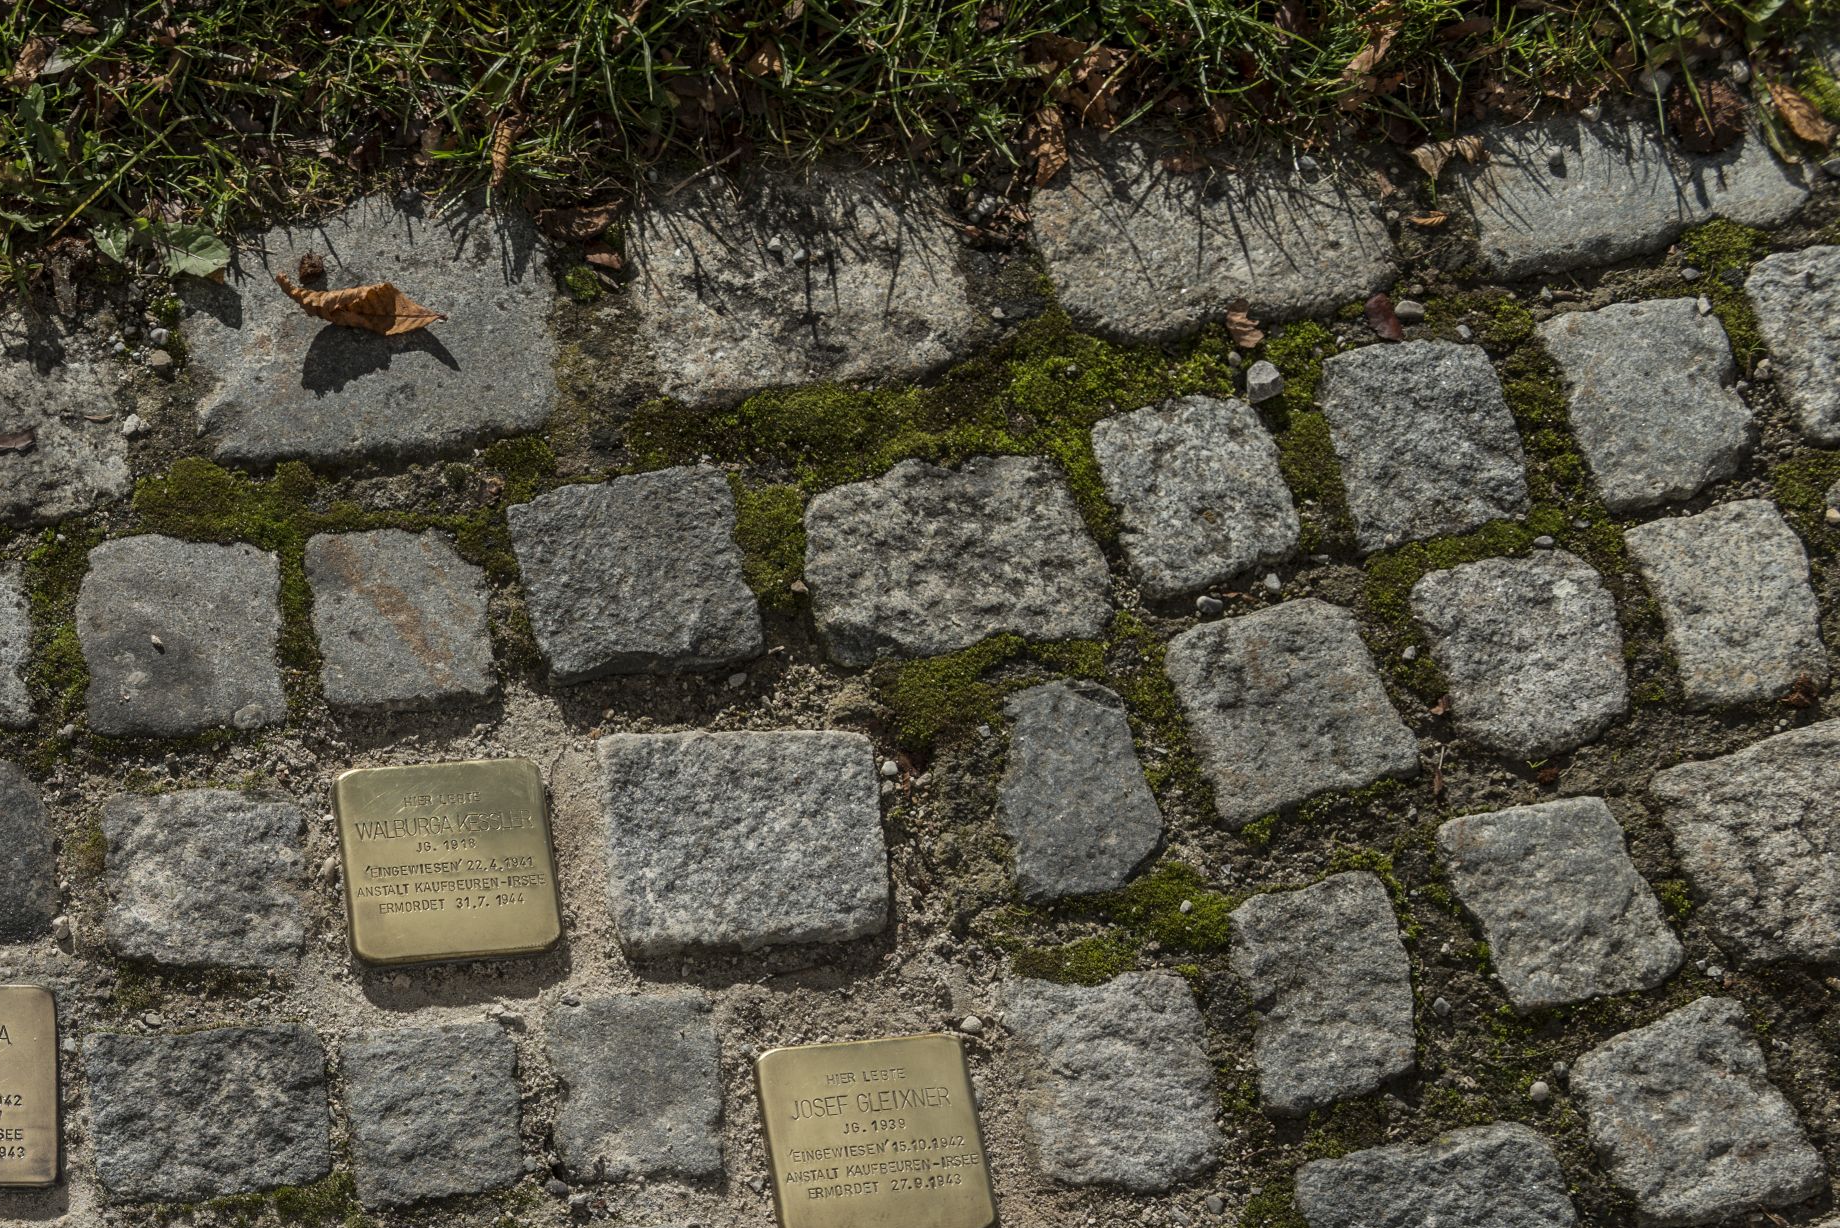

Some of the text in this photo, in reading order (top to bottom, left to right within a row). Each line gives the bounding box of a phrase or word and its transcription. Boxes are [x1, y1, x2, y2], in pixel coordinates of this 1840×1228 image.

[403, 792, 481, 807] HIER LEBTE
[355, 810, 535, 840] WALBURGA KESSLER
[416, 842, 437, 853] JG.
[357, 873, 546, 898] ANSTALT KAUFBEUREN-IRSEE
[379, 899, 445, 914] ERMORDET
[827, 1068, 906, 1085] HIER LEBTE
[791, 1087, 951, 1121] JOSEF GLEIXNER
[843, 1118, 906, 1135] JG. 1939
[786, 1154, 979, 1184] ANSTALT KAUFBEUREN-IRSEE
[809, 1181, 879, 1199] ERMORDET
